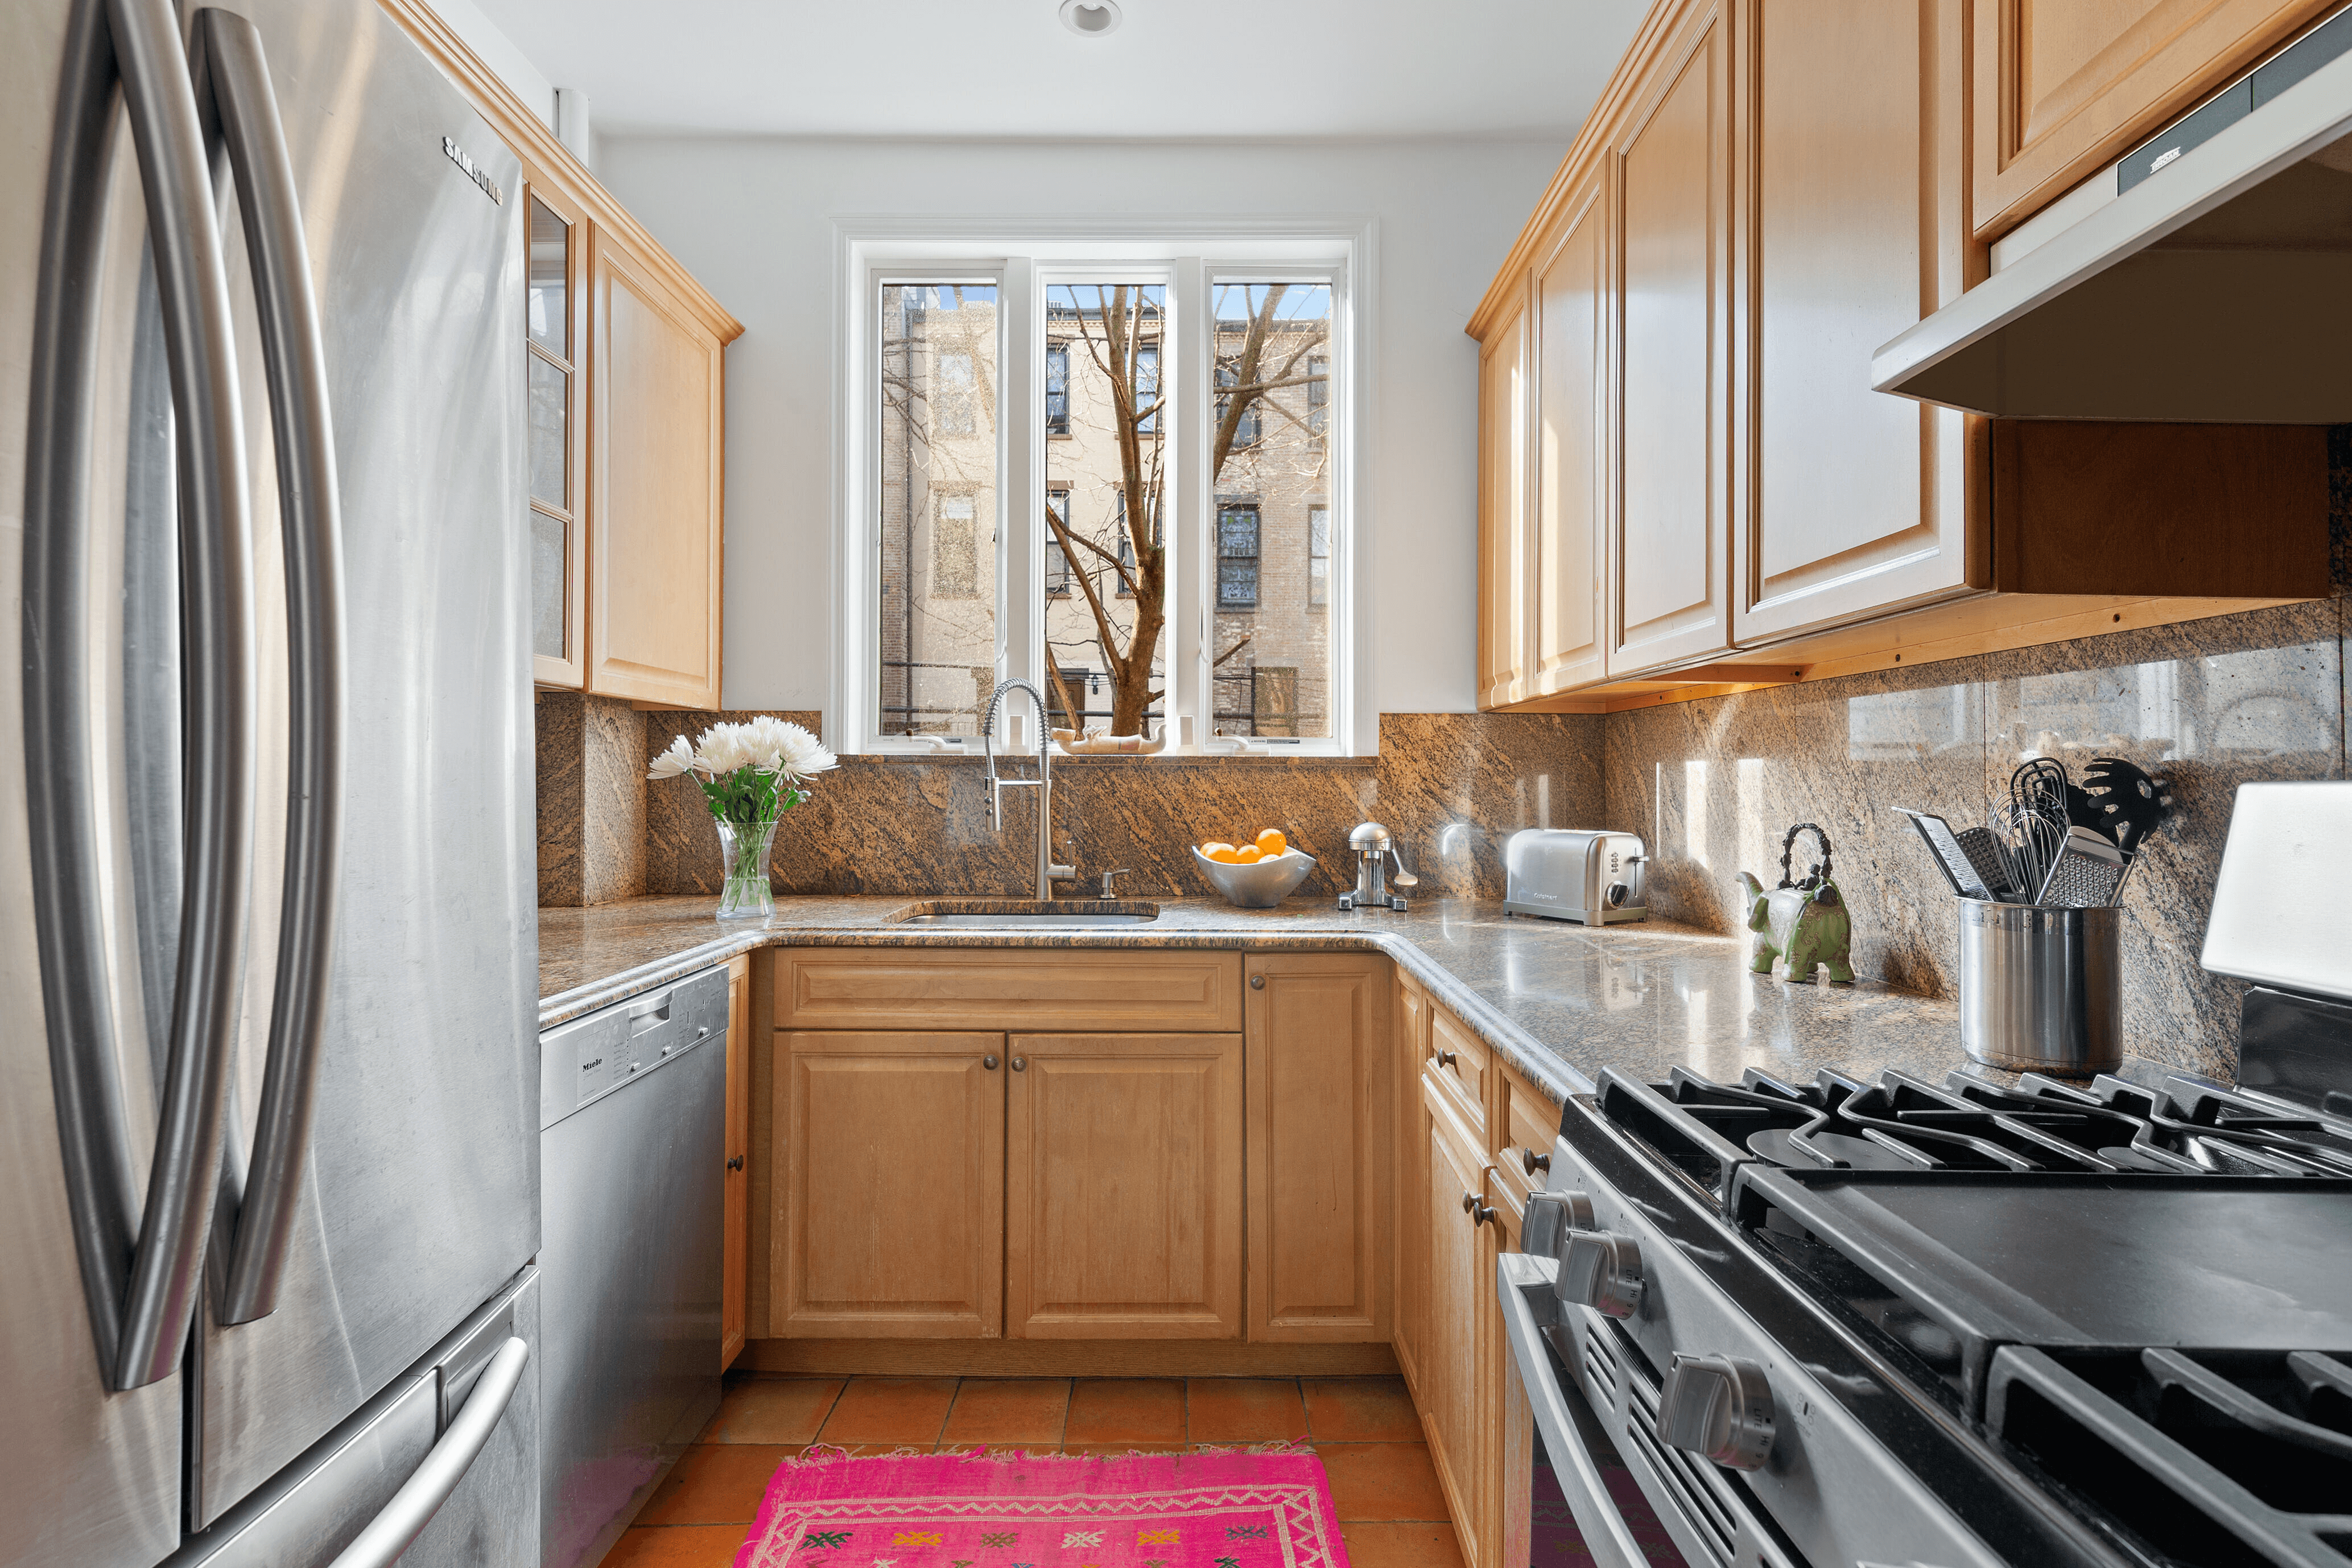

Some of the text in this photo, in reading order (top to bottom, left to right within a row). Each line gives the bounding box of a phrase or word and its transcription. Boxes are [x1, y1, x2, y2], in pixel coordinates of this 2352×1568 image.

[2152, 149, 2179, 171] BROAN
[443, 137, 502, 206] SAMSUNG
[583, 1058, 603, 1072] Miele
[1753, 1408, 1762, 1429] LITE
